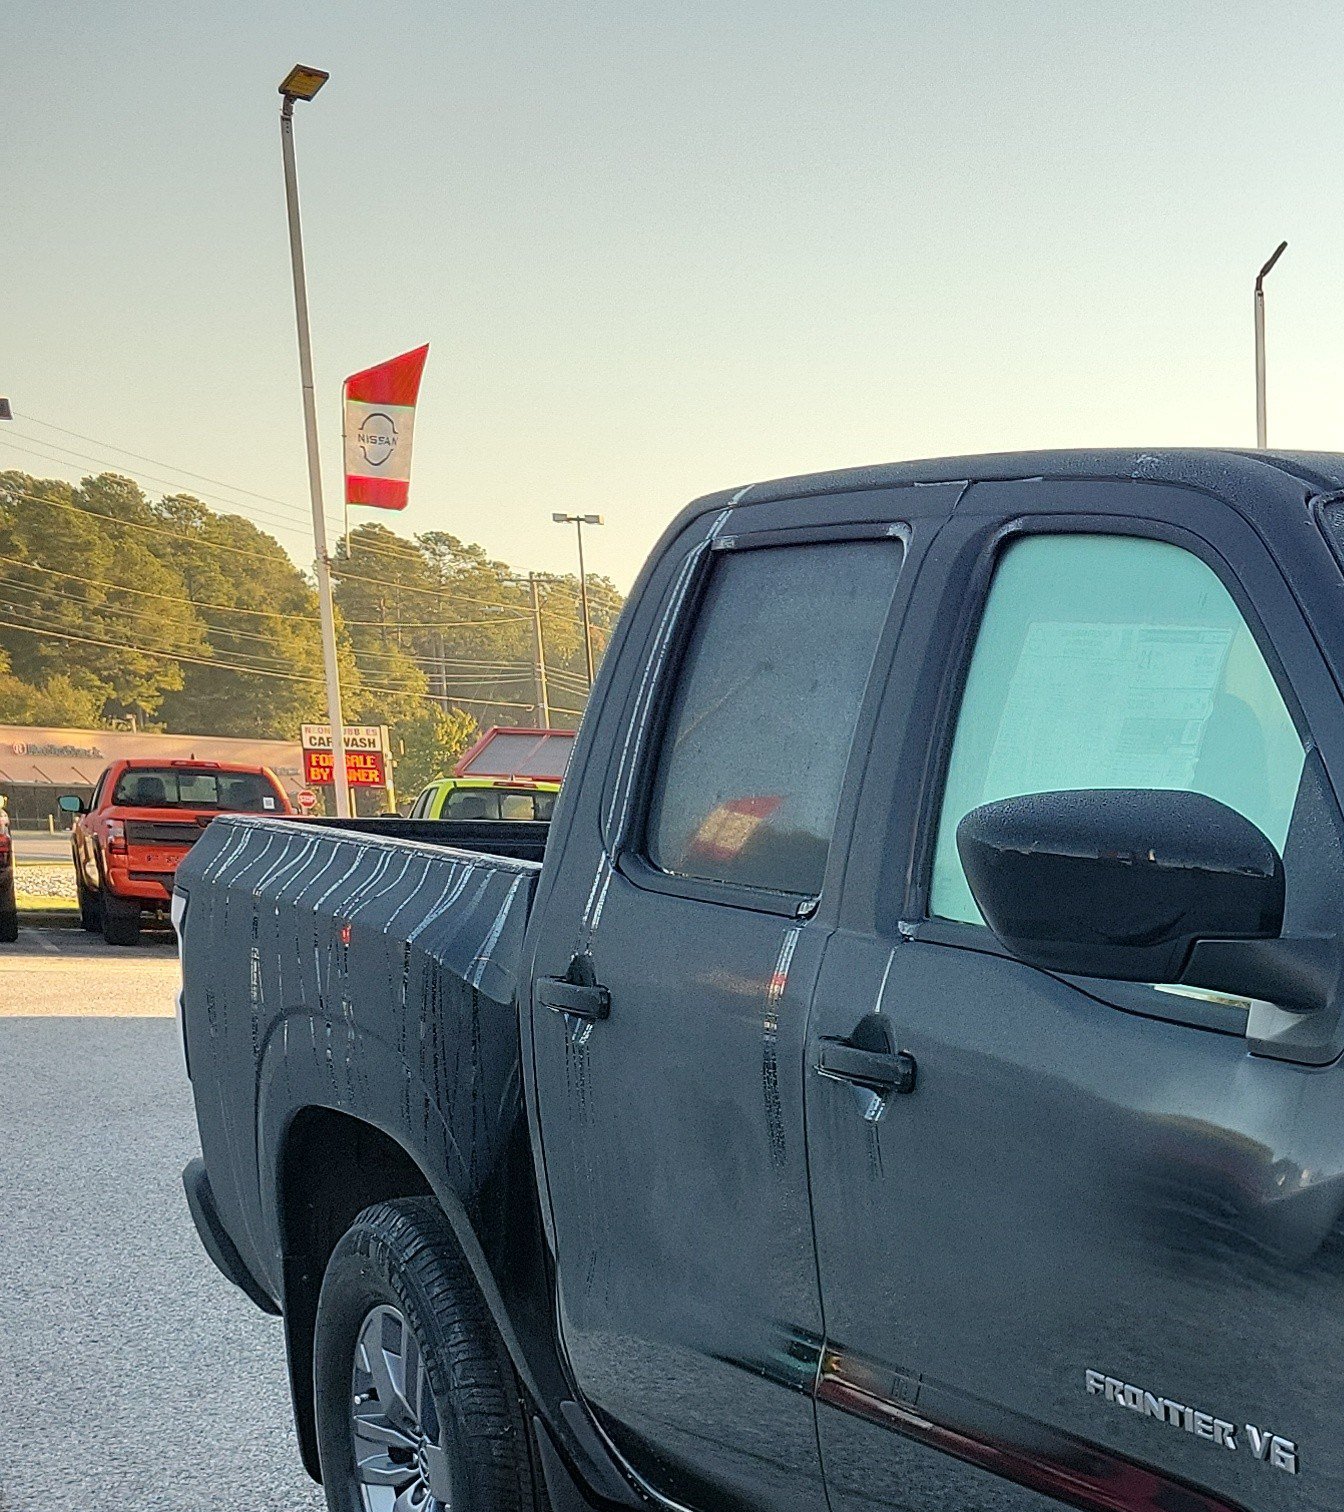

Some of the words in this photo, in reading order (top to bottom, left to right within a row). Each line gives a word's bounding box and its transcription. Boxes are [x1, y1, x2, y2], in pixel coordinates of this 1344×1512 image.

[357, 433, 399, 446] NISSAN
[309, 767, 331, 781] BY
[1085, 1368, 1237, 1451] FRONTIER
[1245, 1423, 1298, 1476] V6
